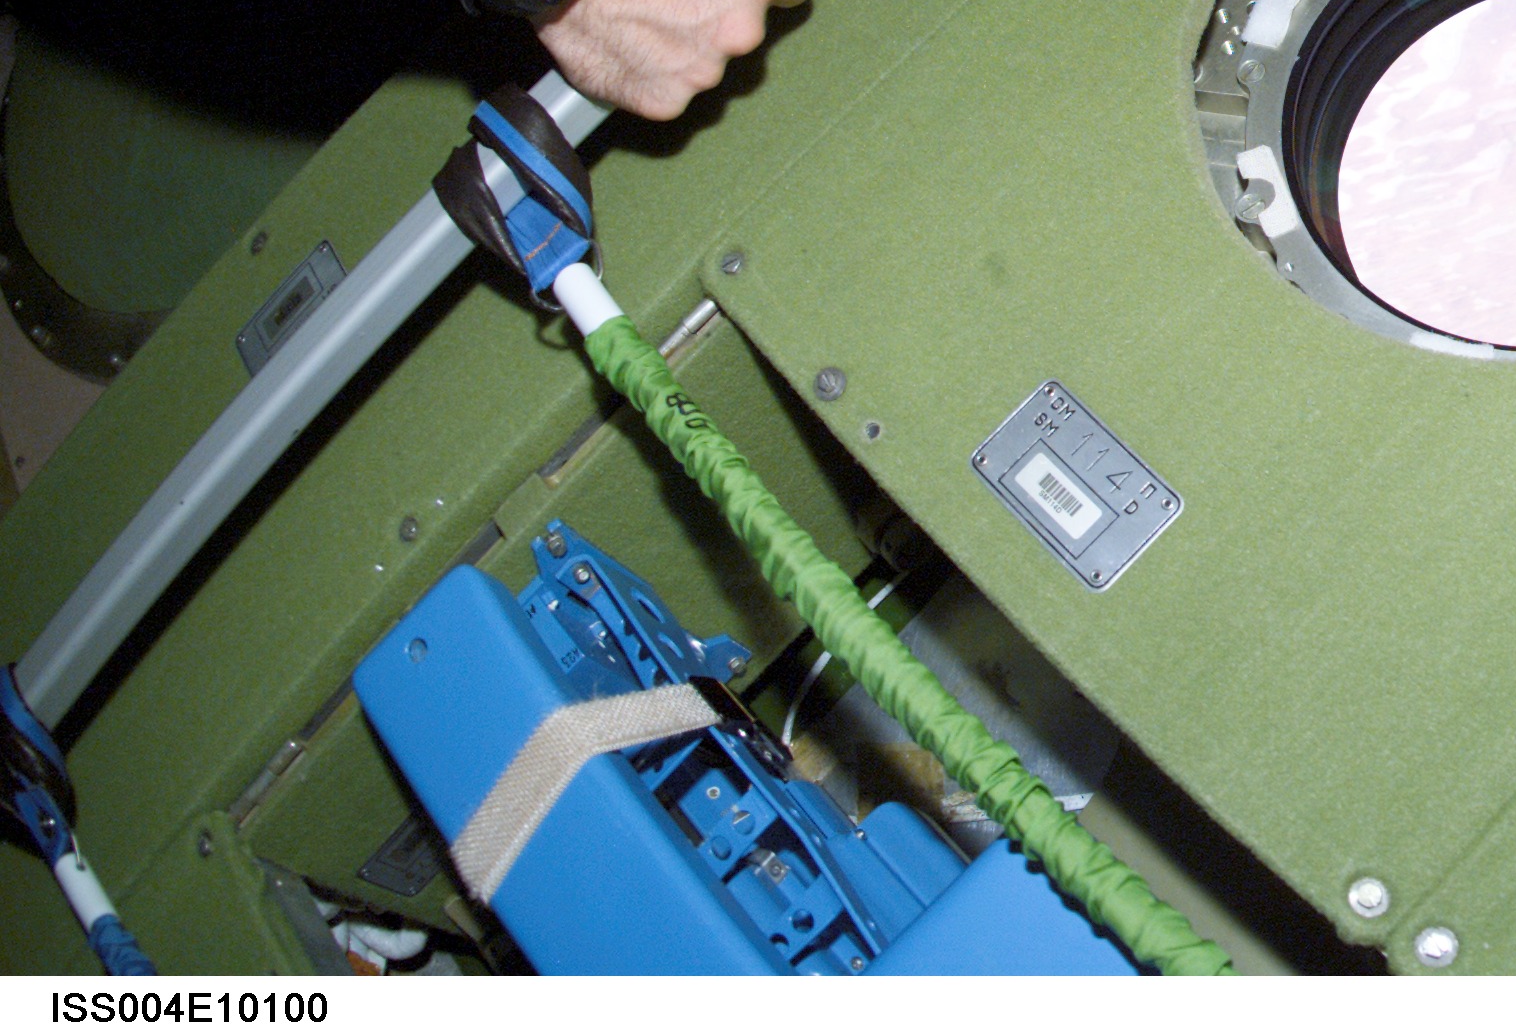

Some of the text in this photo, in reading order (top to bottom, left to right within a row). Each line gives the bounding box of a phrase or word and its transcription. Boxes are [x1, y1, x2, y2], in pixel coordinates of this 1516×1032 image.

[1034, 412, 1060, 437] SM
[1071, 432, 1134, 494] 114
[1121, 498, 1139, 516] D
